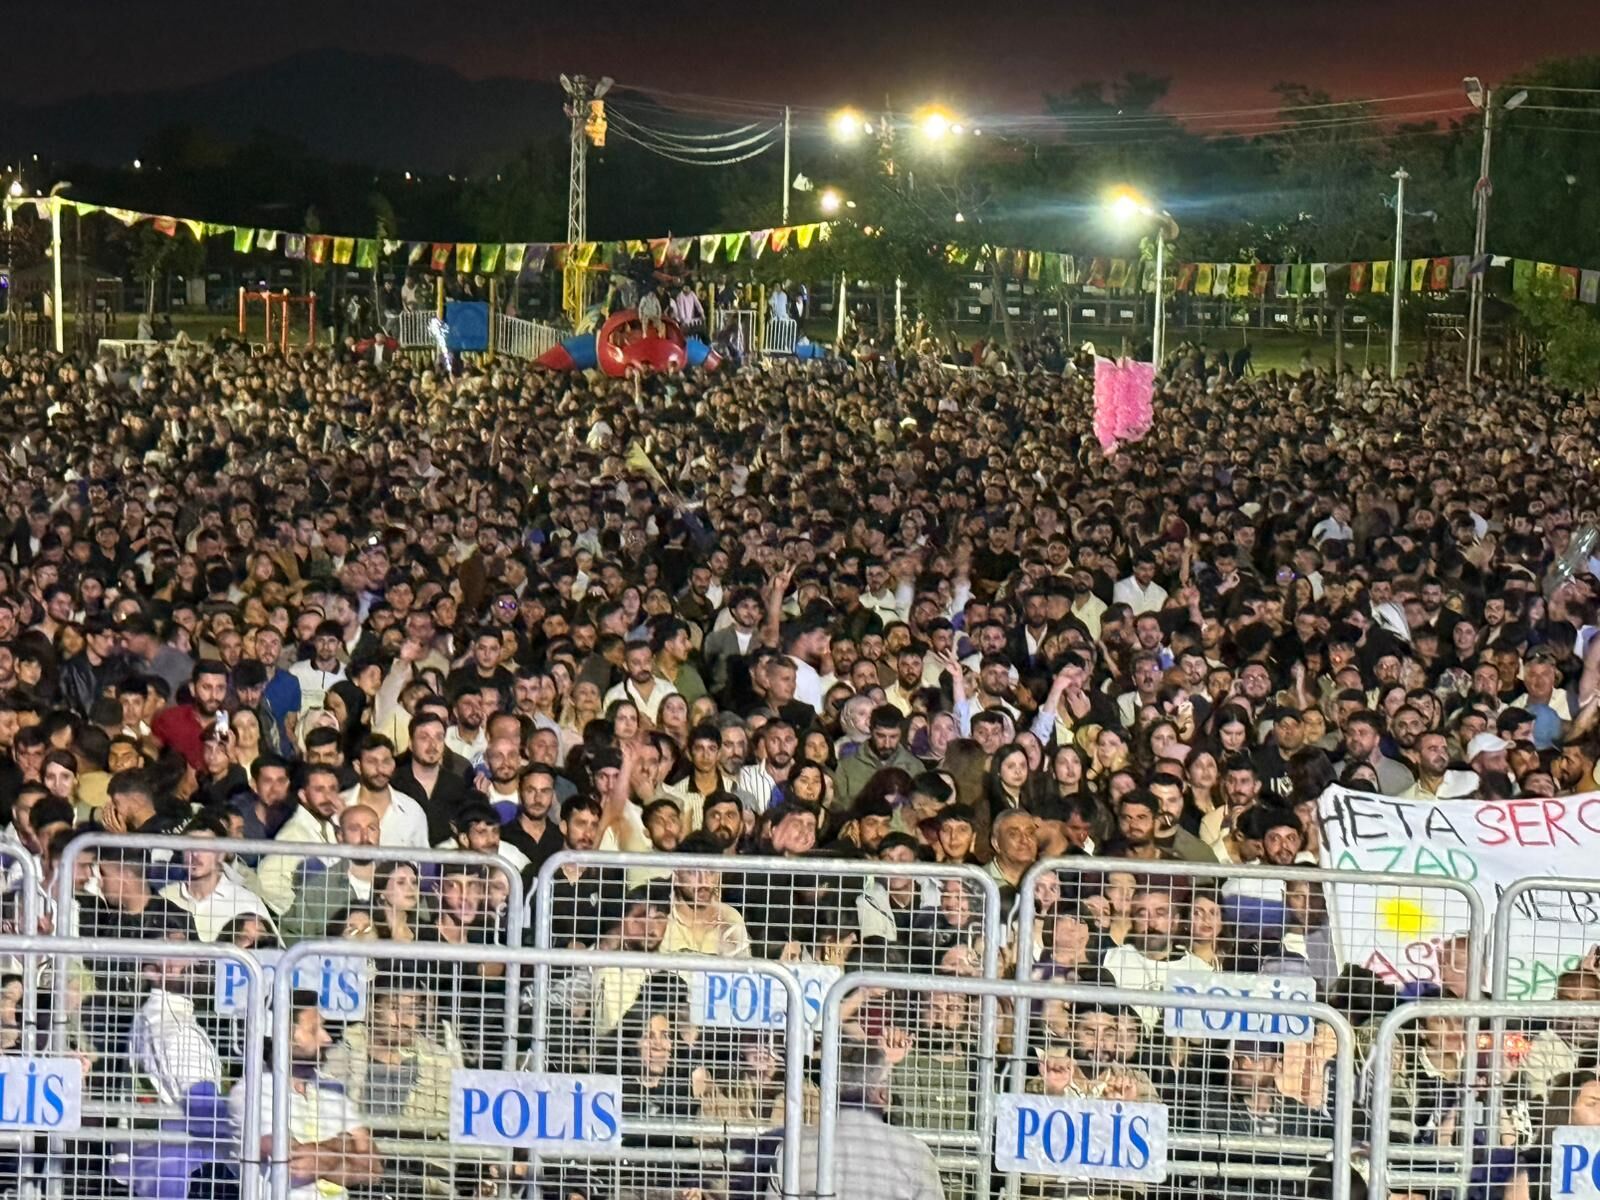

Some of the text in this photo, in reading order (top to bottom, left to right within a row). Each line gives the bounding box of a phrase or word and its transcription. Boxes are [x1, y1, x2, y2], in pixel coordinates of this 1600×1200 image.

[1317, 794, 1468, 852] HETA
[1495, 882, 1600, 926] NEB
[224, 958, 360, 1013] PİS
[706, 968, 822, 1026] POLS
[460, 1081, 618, 1142] POLİS
[1015, 1102, 1151, 1171] POLİS
[1557, 1144, 1600, 1195] P
